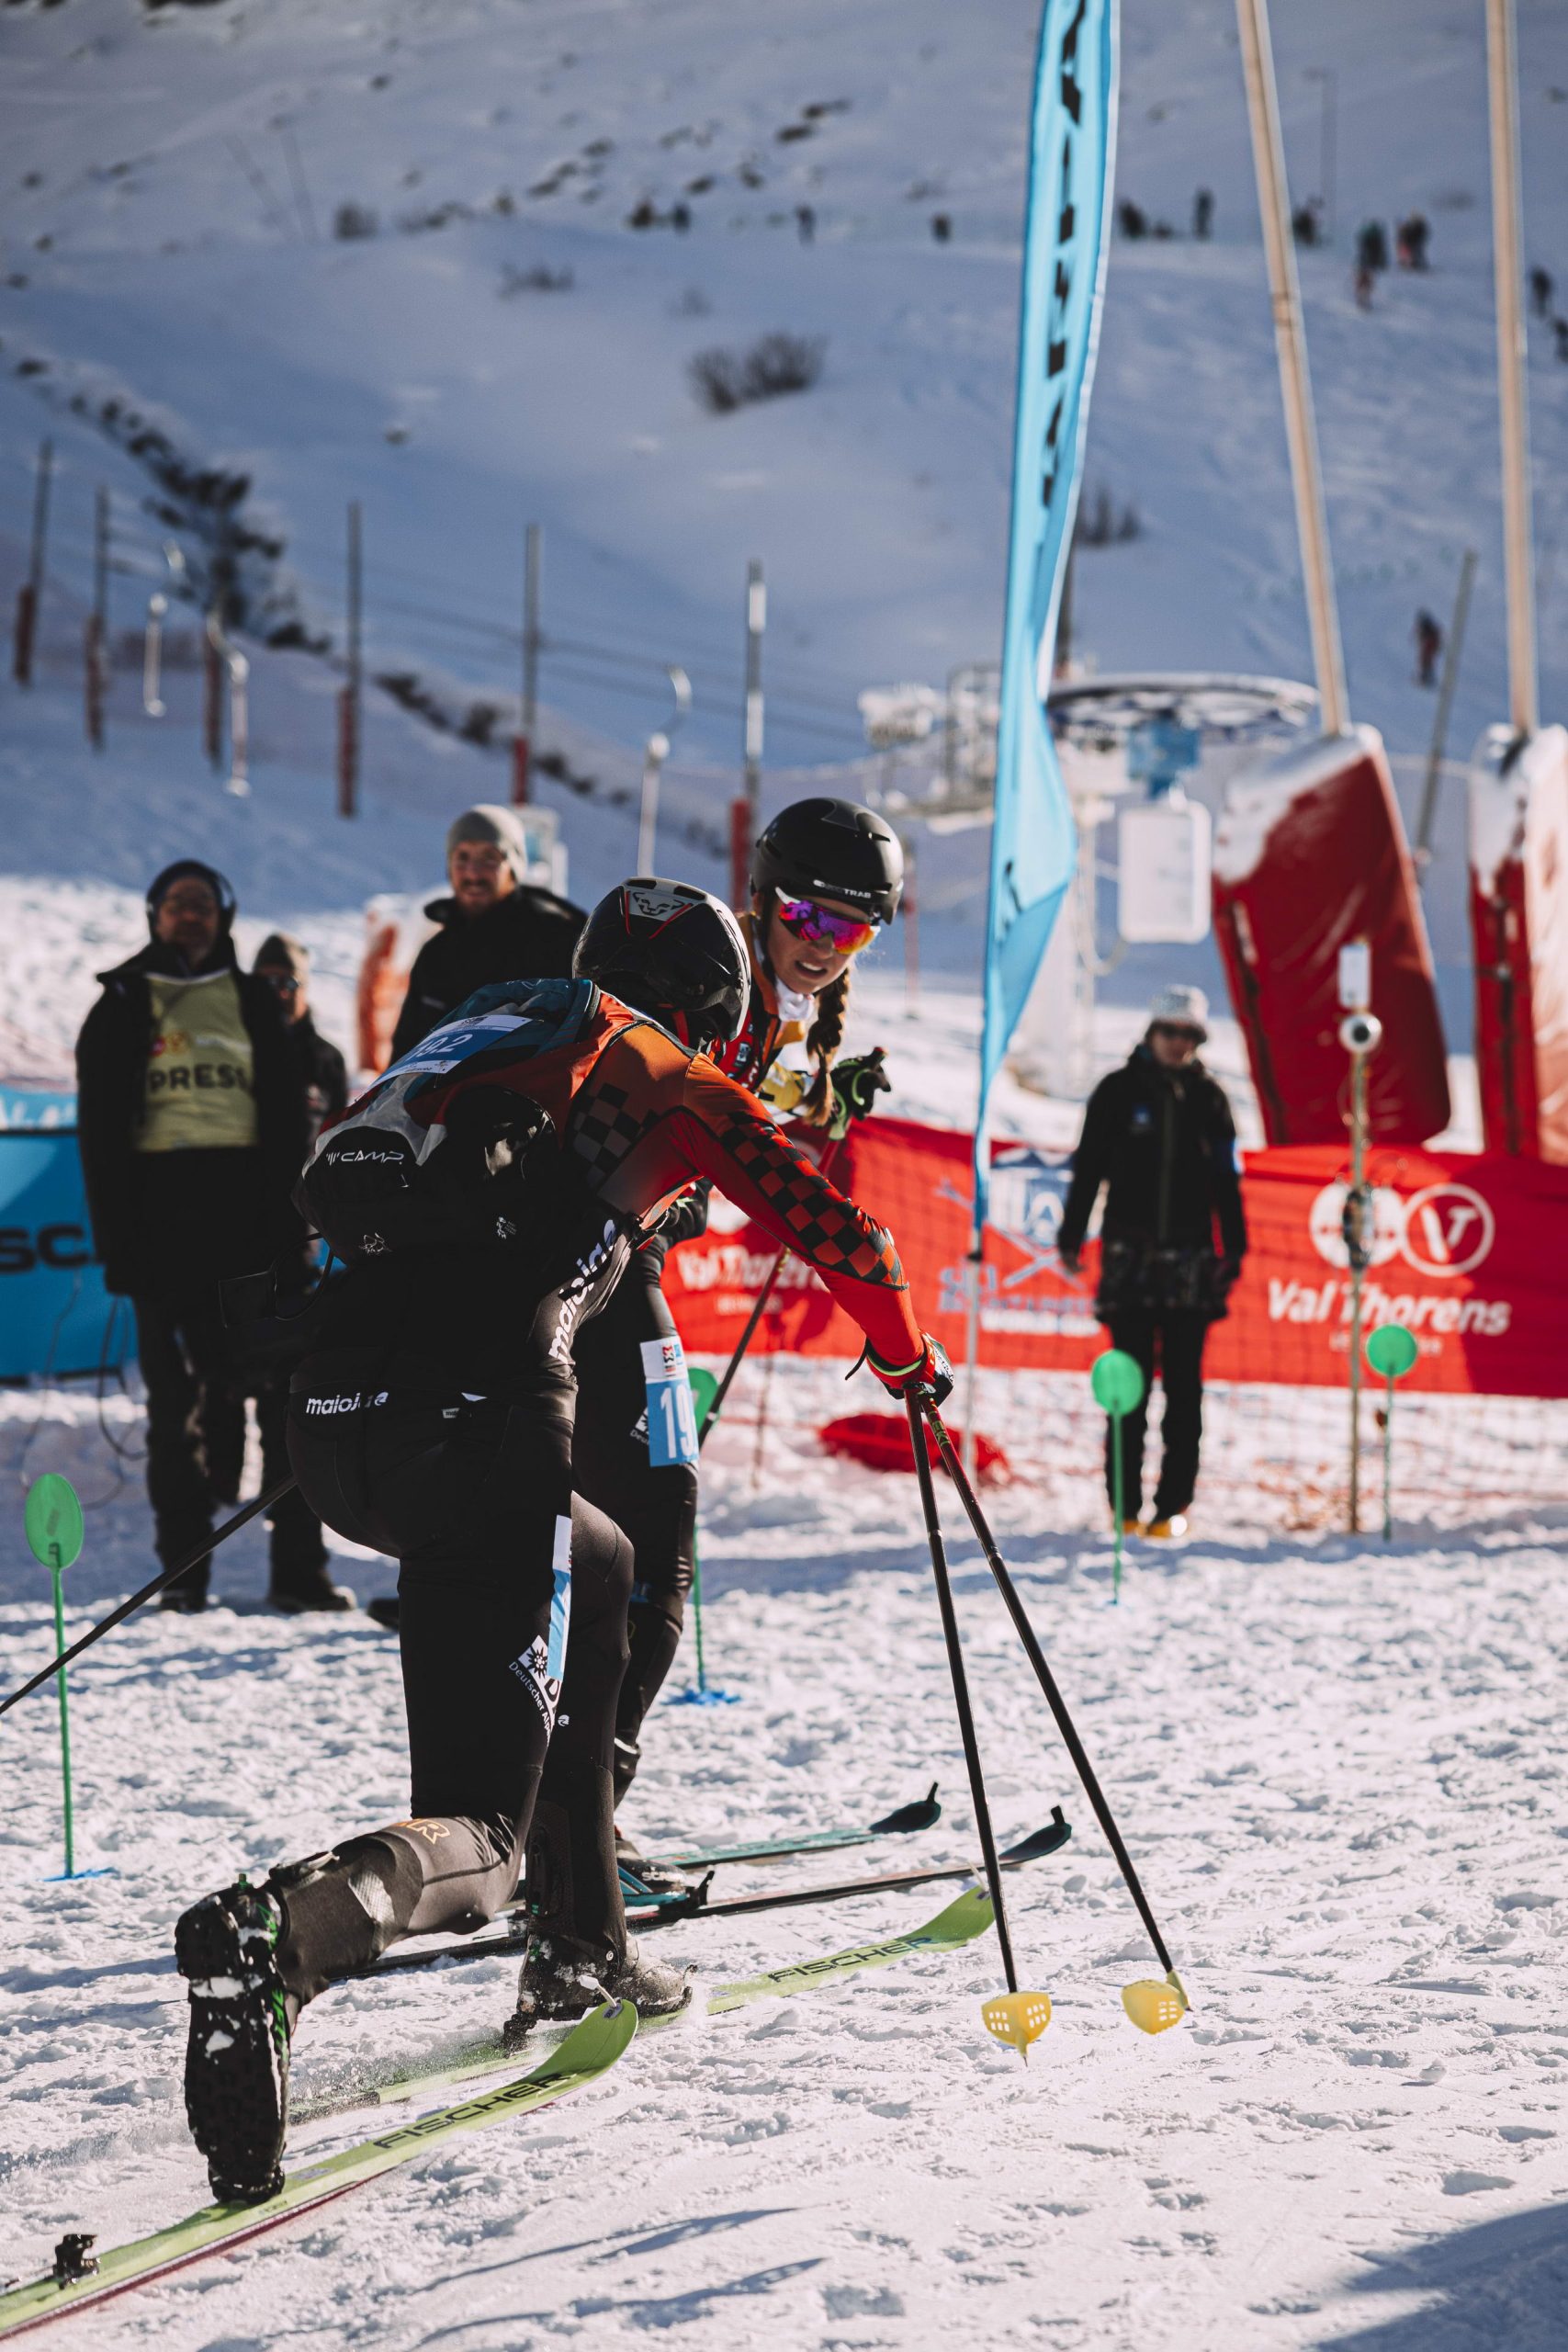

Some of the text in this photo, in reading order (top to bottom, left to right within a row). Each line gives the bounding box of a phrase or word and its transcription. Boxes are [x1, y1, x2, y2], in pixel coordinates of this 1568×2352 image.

[1267, 1276, 1513, 1337] Val Thorens
[508, 1661, 545, 1711] Deutscher
[767, 1936, 933, 1983] FISCHER
[372, 2072, 571, 2149] FISCHER
